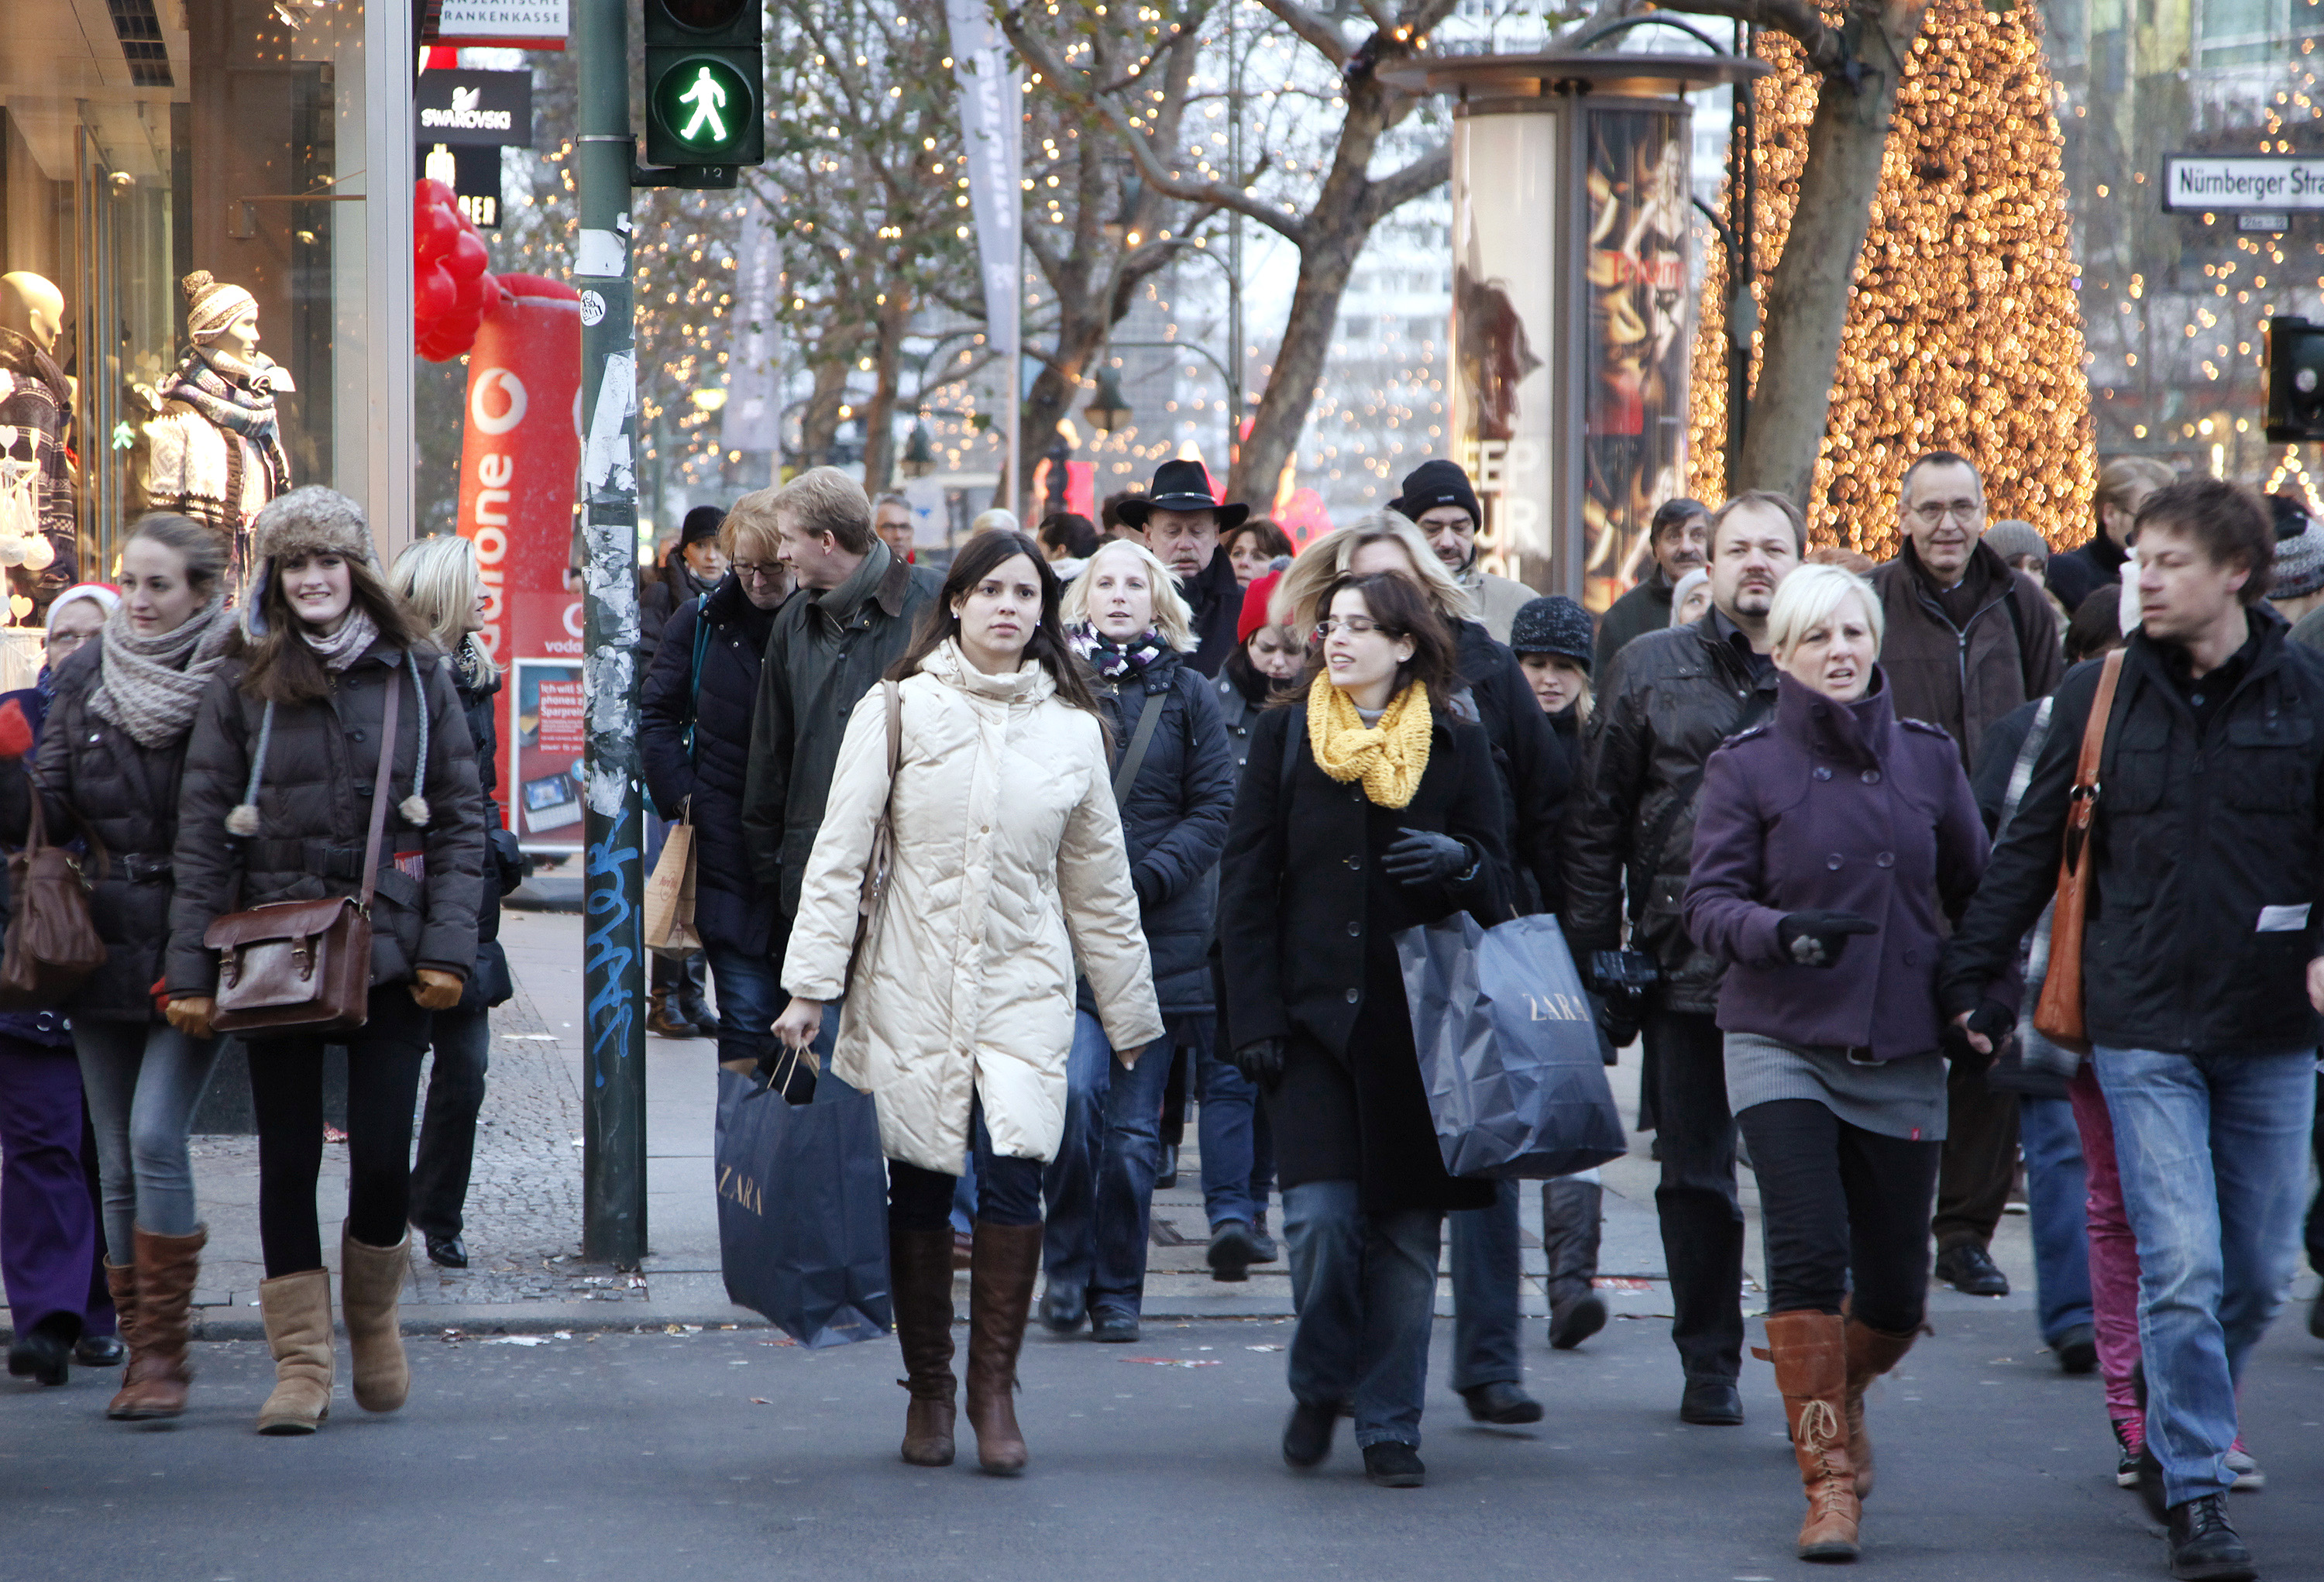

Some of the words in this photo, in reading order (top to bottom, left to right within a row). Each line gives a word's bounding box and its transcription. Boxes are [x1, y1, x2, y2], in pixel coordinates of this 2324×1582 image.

[421, 108, 511, 129] SWAROVSKI
[2180, 166, 2284, 200] Nürnberger
[1521, 992, 1590, 1021] ZARA
[718, 1163, 762, 1216] ZARA
